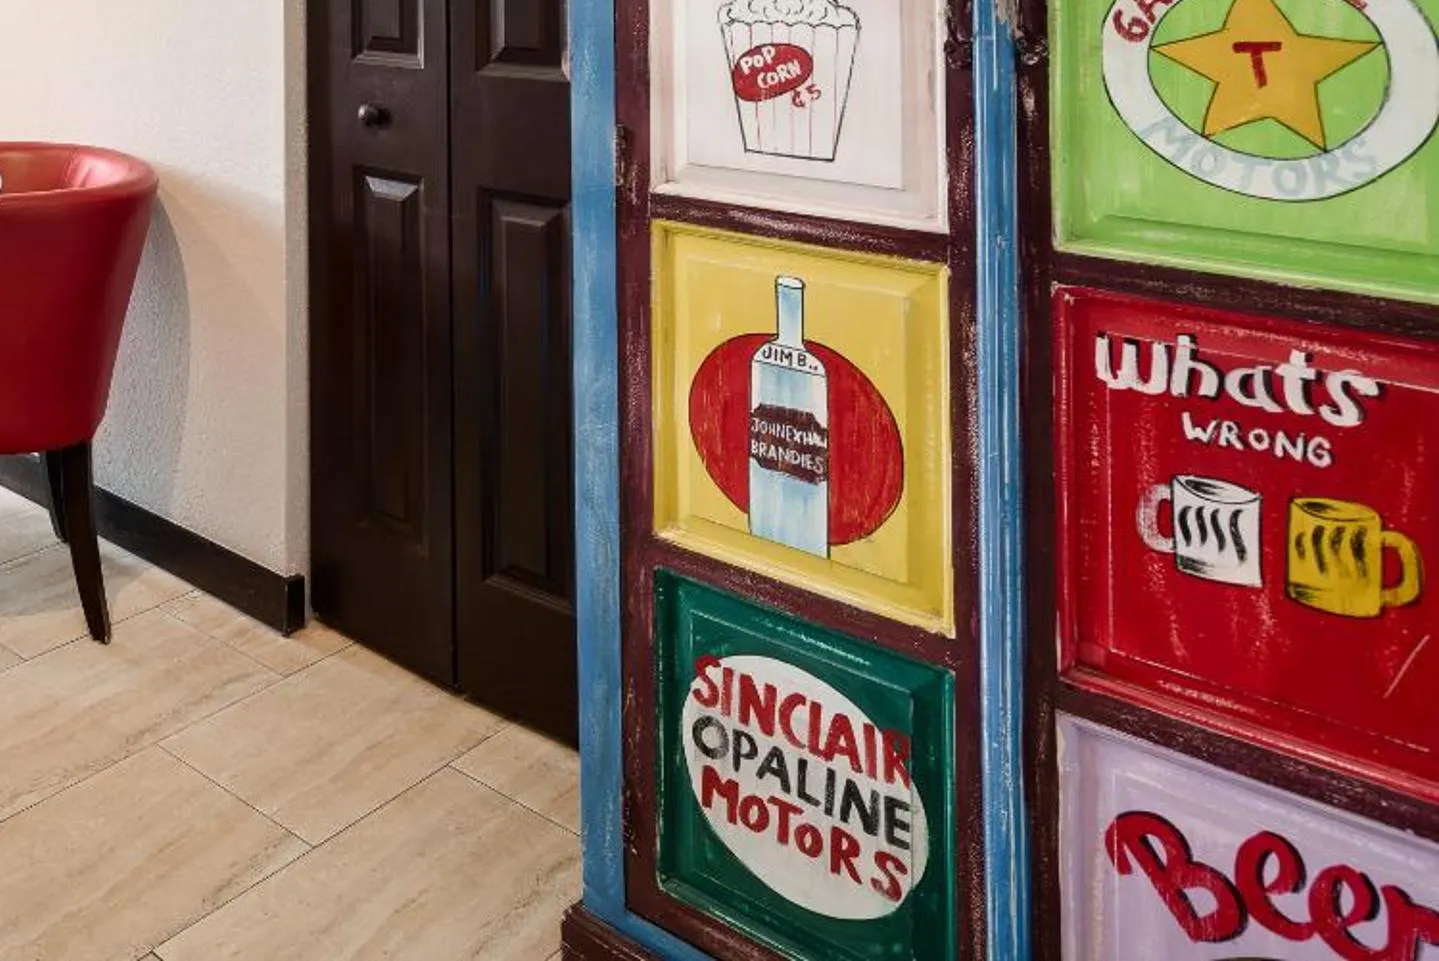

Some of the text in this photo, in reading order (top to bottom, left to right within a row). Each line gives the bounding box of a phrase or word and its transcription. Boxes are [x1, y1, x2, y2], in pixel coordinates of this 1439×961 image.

[1232, 41, 1282, 89] T
[1136, 114, 1379, 196] MOTORS
[763, 345, 794, 367] JIM
[750, 438, 825, 475] BRANDIES
[1181, 411, 1334, 468] WRONG
[692, 654, 911, 791] SINCLAIR
[691, 715, 911, 851] OPALINE
[701, 765, 910, 903] MOTORS
[1105, 810, 1439, 961] Beer
